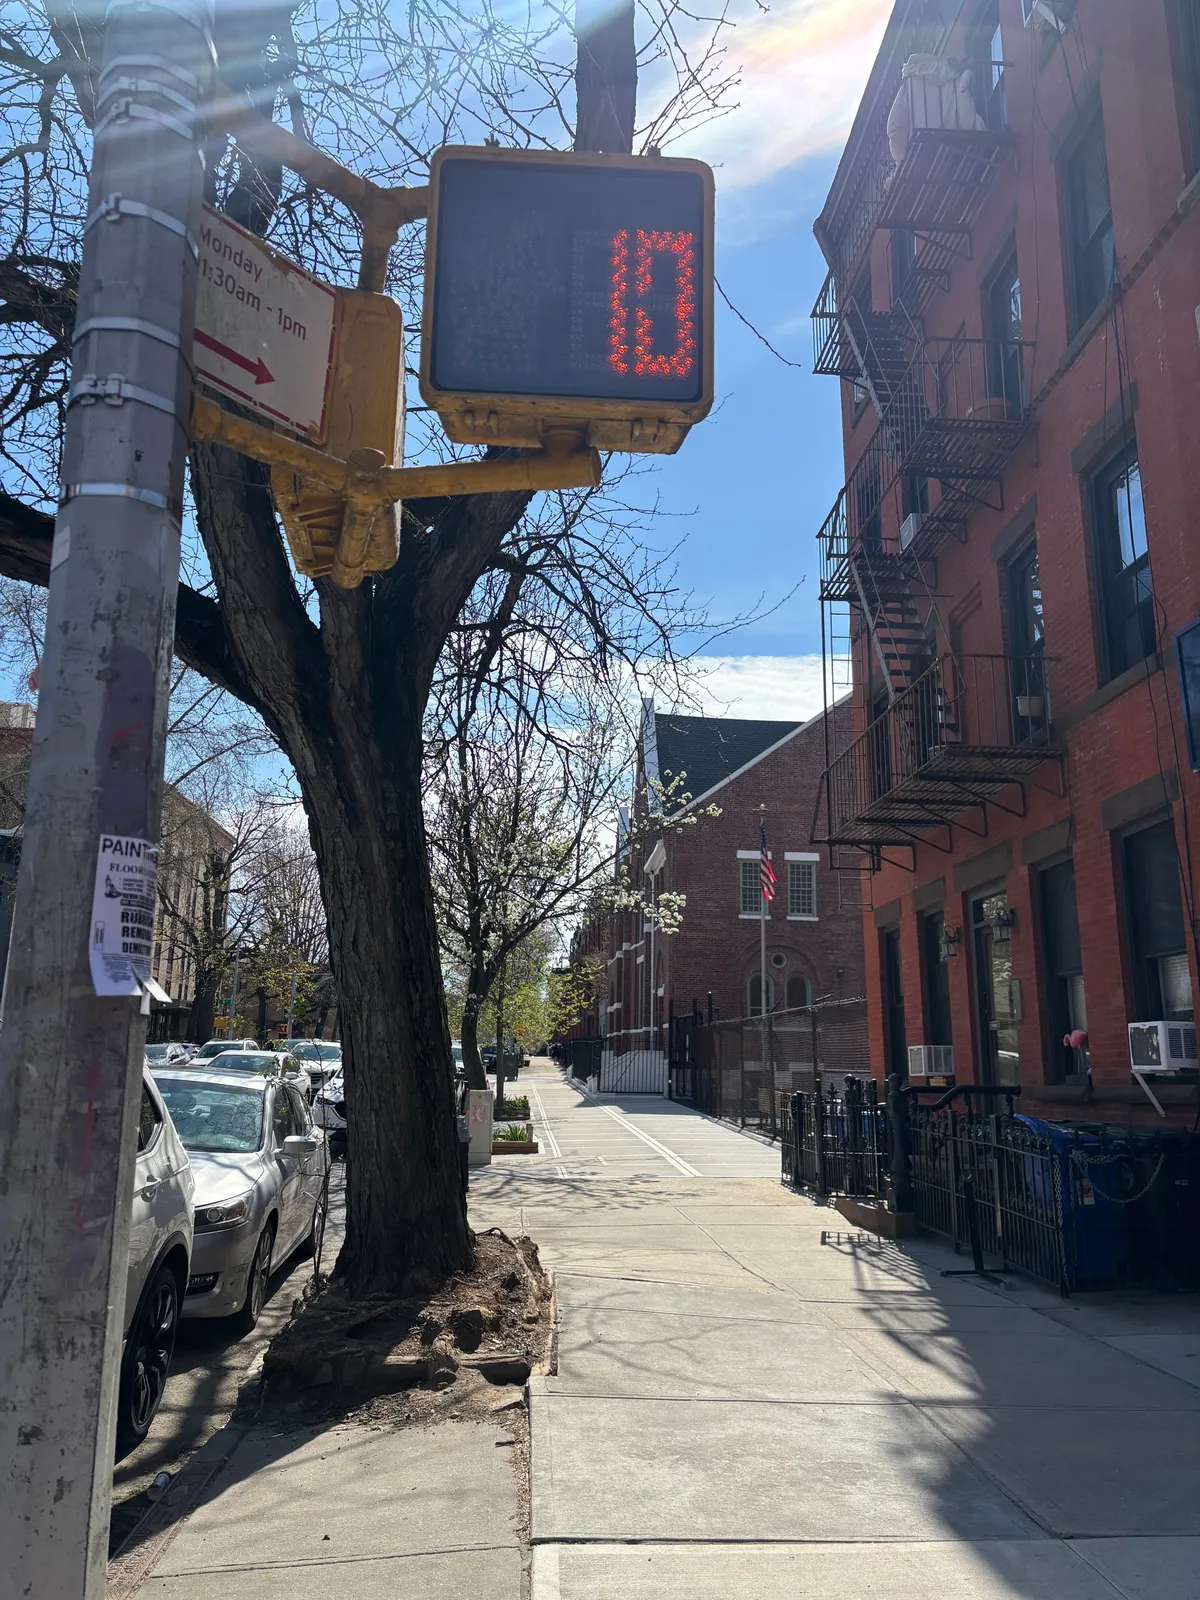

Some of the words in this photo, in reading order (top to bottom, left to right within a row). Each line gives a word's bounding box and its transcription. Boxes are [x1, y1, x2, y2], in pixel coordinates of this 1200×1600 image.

[200, 222, 263, 283] Monday
[277, 307, 307, 341] 1pm
[609, 229, 695, 376] 10
